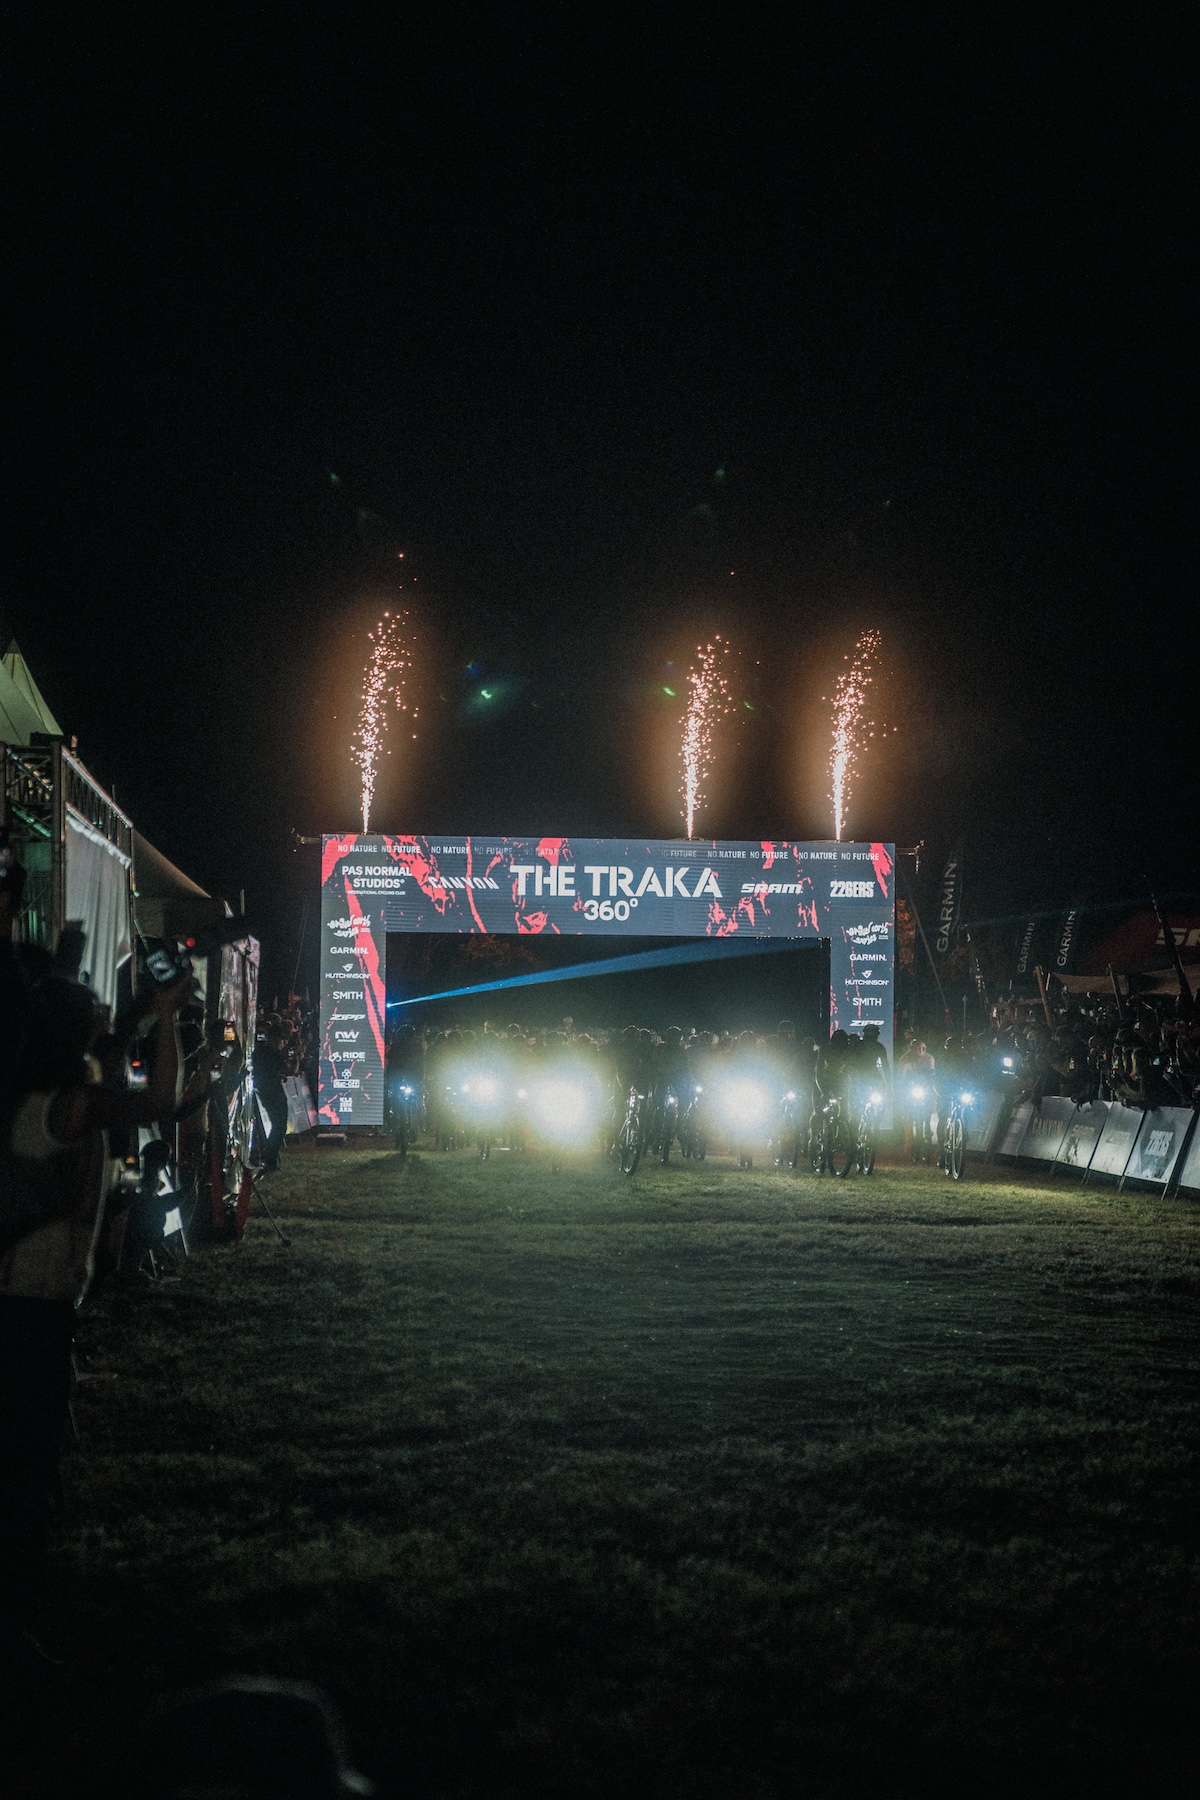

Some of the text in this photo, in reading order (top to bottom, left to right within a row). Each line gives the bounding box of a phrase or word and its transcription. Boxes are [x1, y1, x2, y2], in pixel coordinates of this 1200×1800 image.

[350, 845, 377, 853] NATURE
[382, 845, 392, 853] NO
[394, 846, 420, 854] FUTURE
[442, 846, 470, 854] NATURE
[486, 847, 512, 855] FUTURE
[762, 852, 788, 860] FUTURE
[810, 852, 837, 860] NATURE
[841, 852, 851, 860] NO
[852, 852, 879, 860] FUTURE
[342, 866, 412, 876] PAS NORMAL
[428, 876, 500, 890] CANYON
[510, 865, 723, 898] THE TRAKA
[830, 880, 875, 898] 226ERS
[936, 860, 958, 952] GARMIN
[1056, 910, 1076, 966] GARMIN
[1017, 922, 1036, 973] GARMIN
[332, 991, 364, 1000] SMITH
[852, 998, 882, 1006] SMITH
